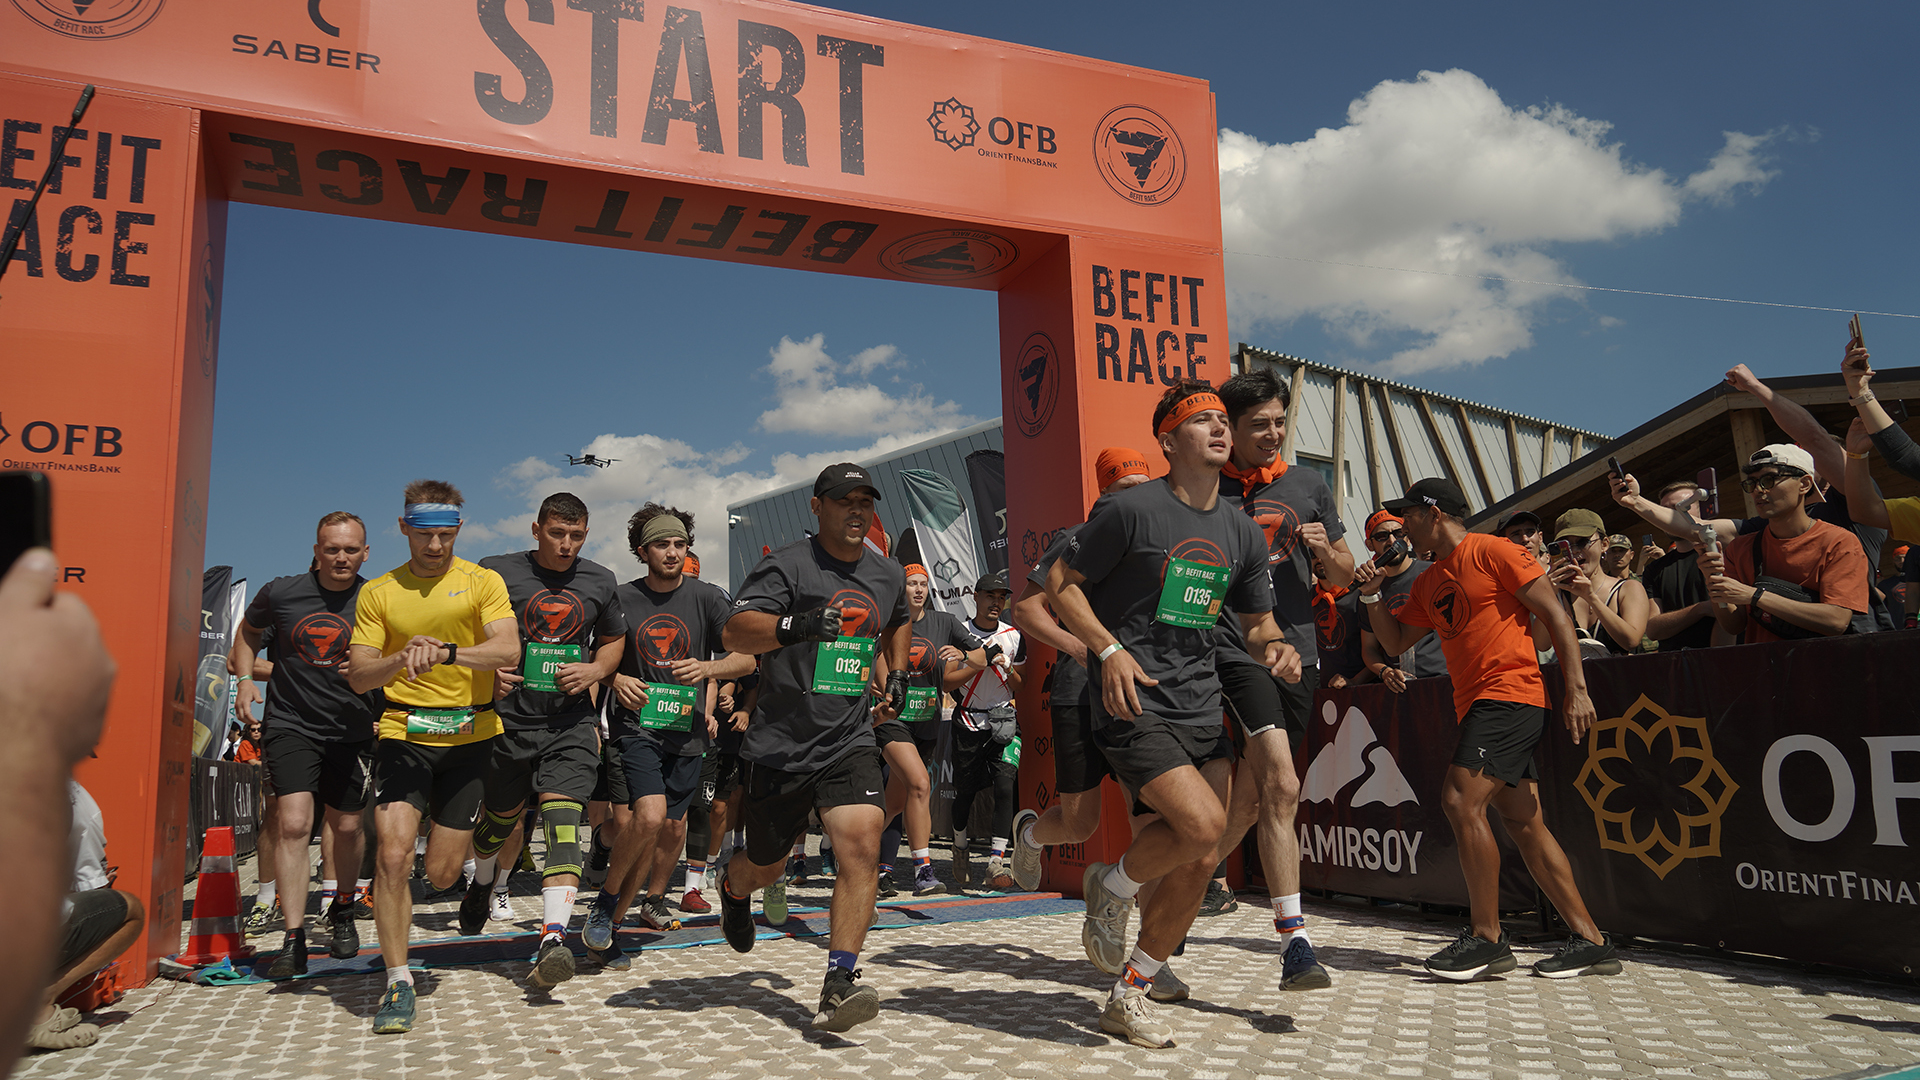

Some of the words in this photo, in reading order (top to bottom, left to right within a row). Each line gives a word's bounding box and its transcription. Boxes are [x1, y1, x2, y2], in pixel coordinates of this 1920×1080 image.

[53, 18, 80, 33] BEFIT
[81, 25, 106, 35] RACE
[231, 34, 382, 74] SABER
[474, 0, 885, 176] START
[987, 116, 1058, 155] OFB
[0, 118, 162, 204] EFIT
[1128, 191, 1145, 202] BEFIT
[1091, 264, 1205, 328] BEFIT
[1095, 322, 1212, 388] RACE
[1186, 394, 1218, 406] BEFIT
[21, 420, 123, 458] OFB
[1122, 460, 1146, 469] BEFIT
[1185, 567, 1202, 579] BEFIT
[1201, 570, 1216, 581] RACE
[1184, 586, 1212, 606] 0135
[199, 631, 225, 640] BER
[834, 641, 849, 650] BEFIT
[849, 642, 861, 650] RACE
[835, 657, 861, 674] 0132
[657, 700, 680, 714] 0145
[909, 699, 927, 709] 0133
[1300, 823, 1423, 874] AMIRSOY
